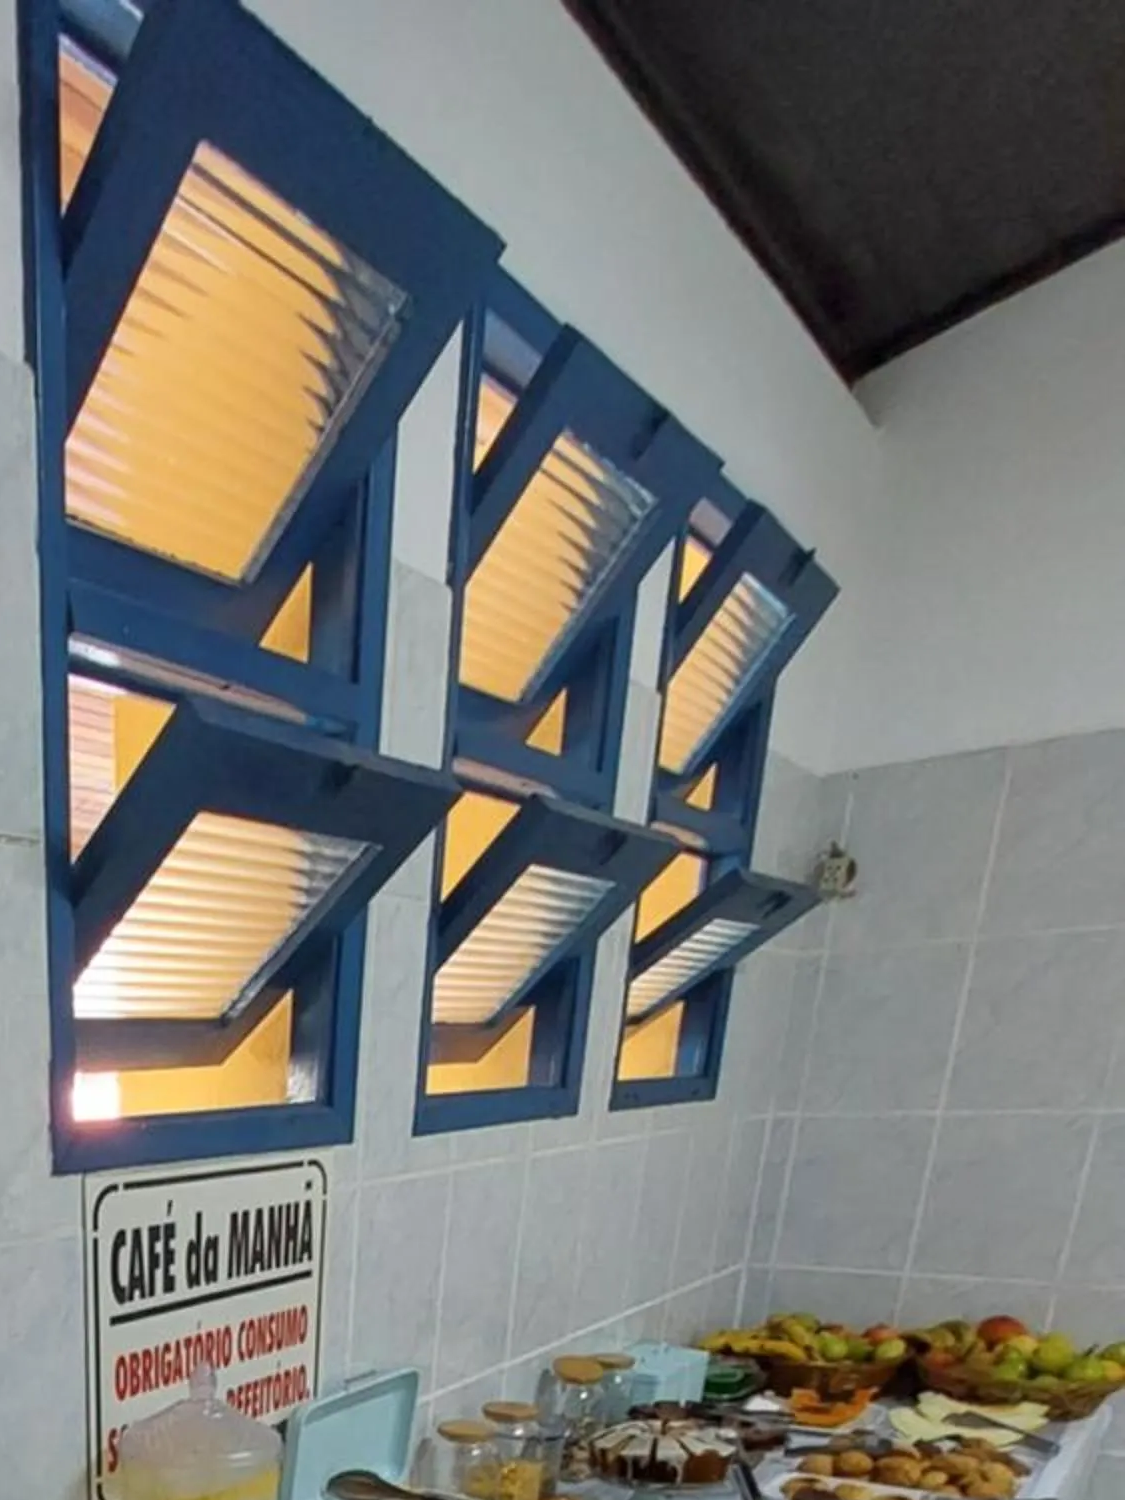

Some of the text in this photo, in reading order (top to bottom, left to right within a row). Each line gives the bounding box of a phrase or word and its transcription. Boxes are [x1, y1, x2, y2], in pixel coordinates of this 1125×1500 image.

[109, 1199, 176, 1305] CAFÉ
[185, 1210, 219, 1289] da
[113, 1304, 309, 1402] OBRIGATÓRIO CONSUMO
